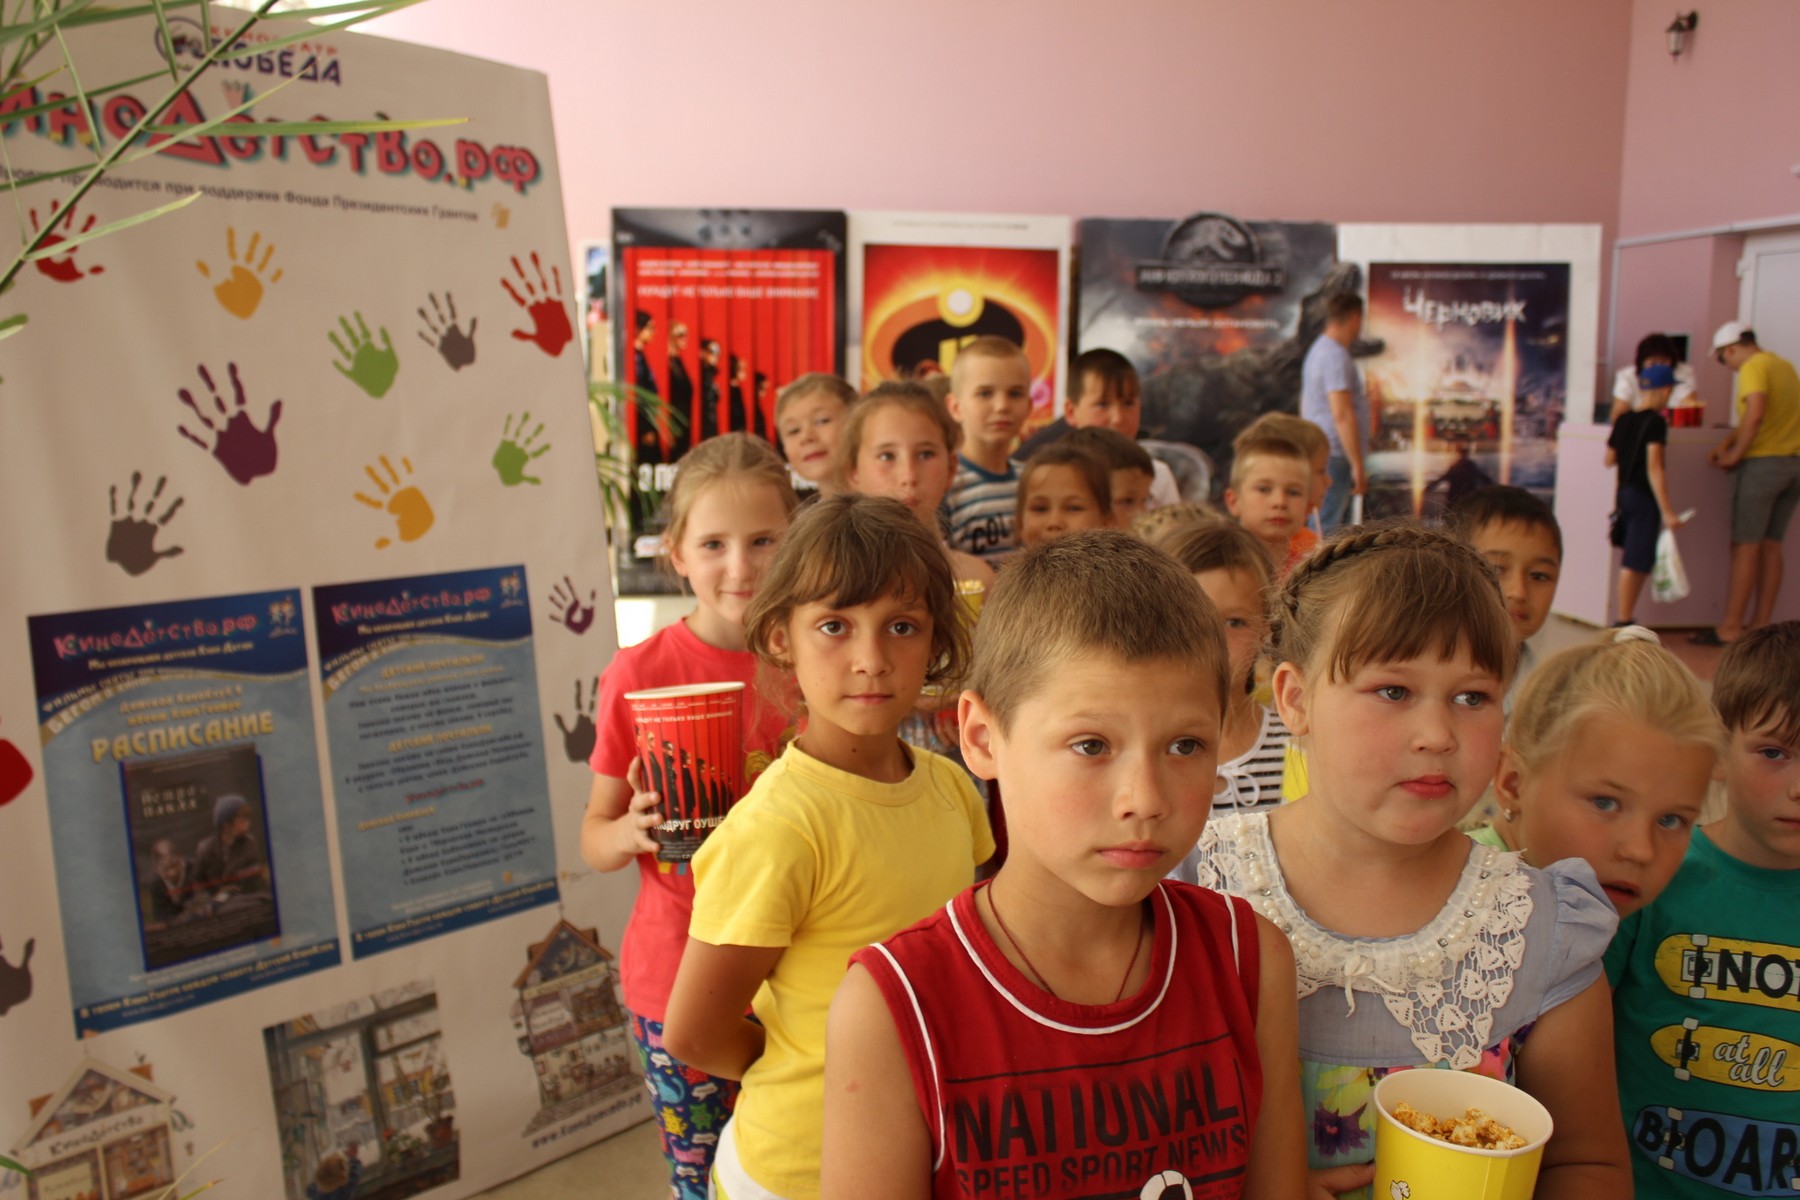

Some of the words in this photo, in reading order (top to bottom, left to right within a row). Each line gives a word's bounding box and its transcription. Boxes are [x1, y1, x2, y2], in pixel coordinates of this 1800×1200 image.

[91, 710, 275, 764] РАСПИСАНИЕ
[1717, 948, 1800, 1002] NO
[1713, 1034, 1750, 1064] at
[1729, 1047, 1787, 1087] all
[957, 1161, 1051, 1200] SPEED
[1061, 1145, 1158, 1194] SPORT
[1169, 1123, 1247, 1170] NEWS
